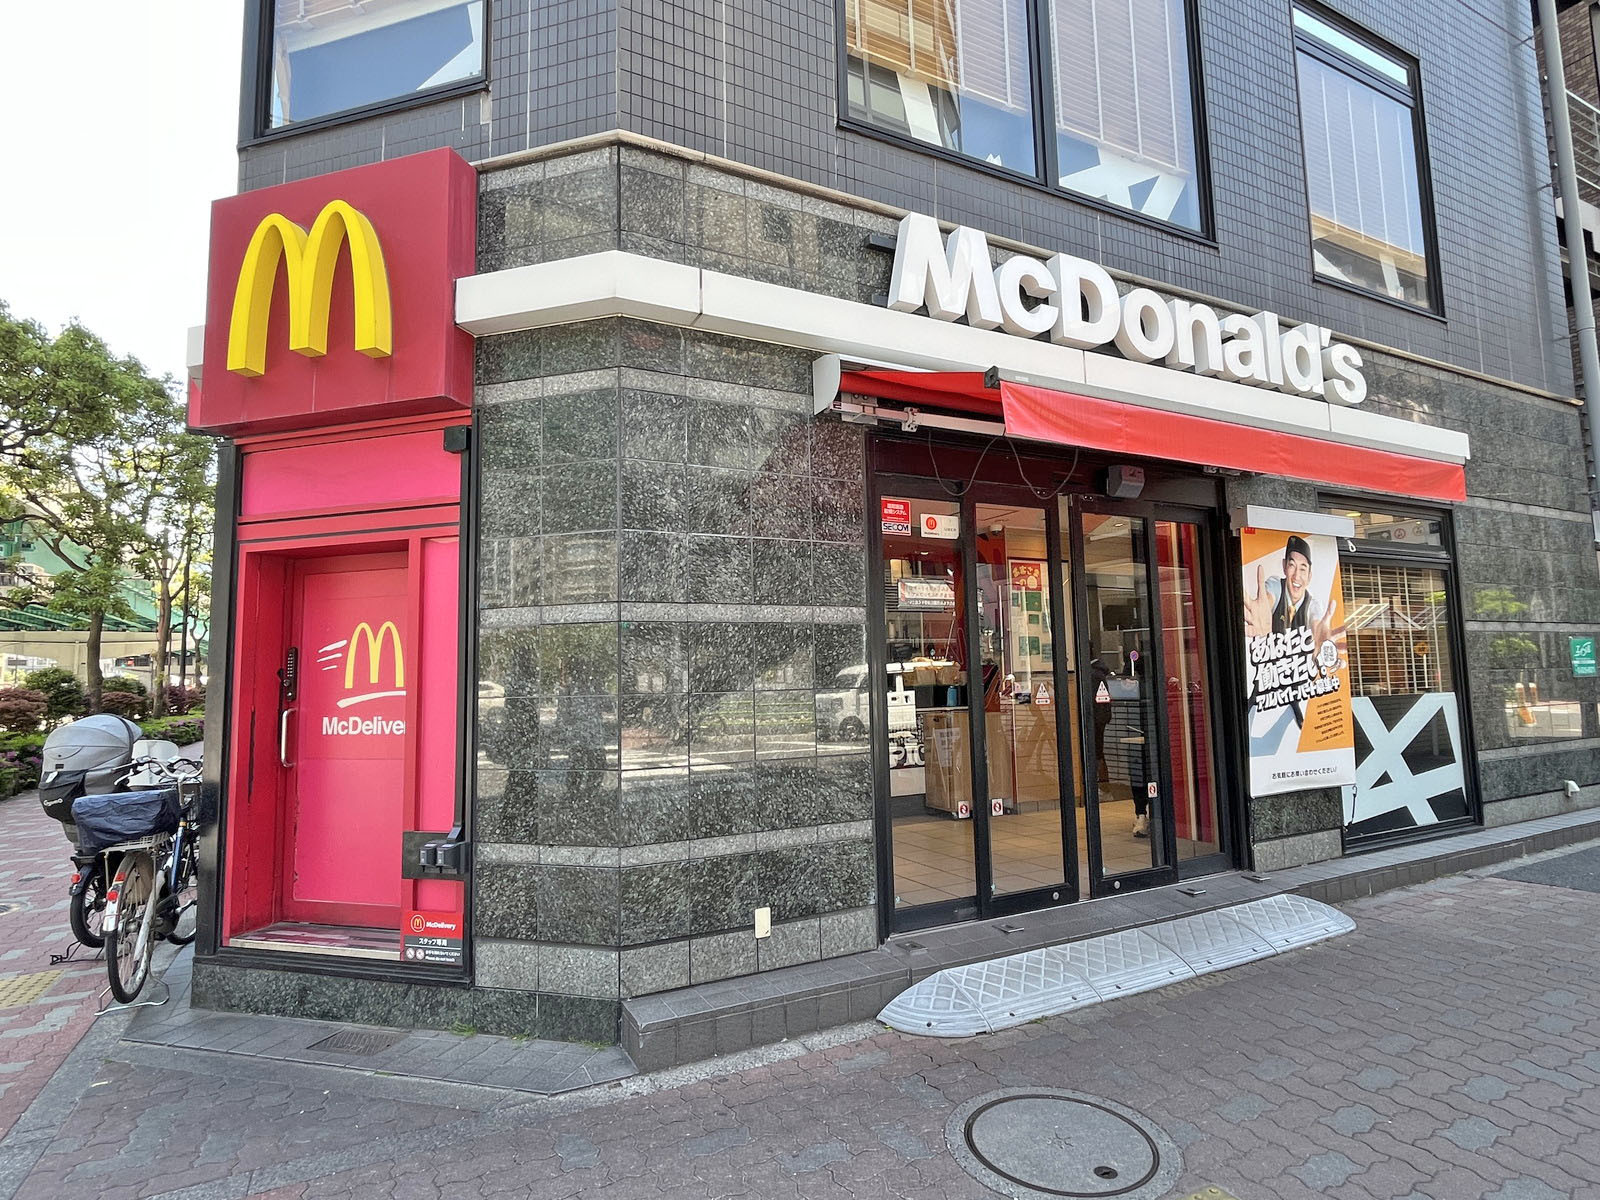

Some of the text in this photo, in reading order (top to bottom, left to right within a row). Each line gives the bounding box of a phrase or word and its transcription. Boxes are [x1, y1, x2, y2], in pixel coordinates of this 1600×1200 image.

[887, 211, 1368, 406] McDonald's
[882, 522, 909, 532] SECOM
[1250, 626, 1316, 663] あなたと
[322, 716, 406, 735] McDelive
[426, 921, 456, 931] McDelivery
[418, 938, 448, 946] スタッフ専用
